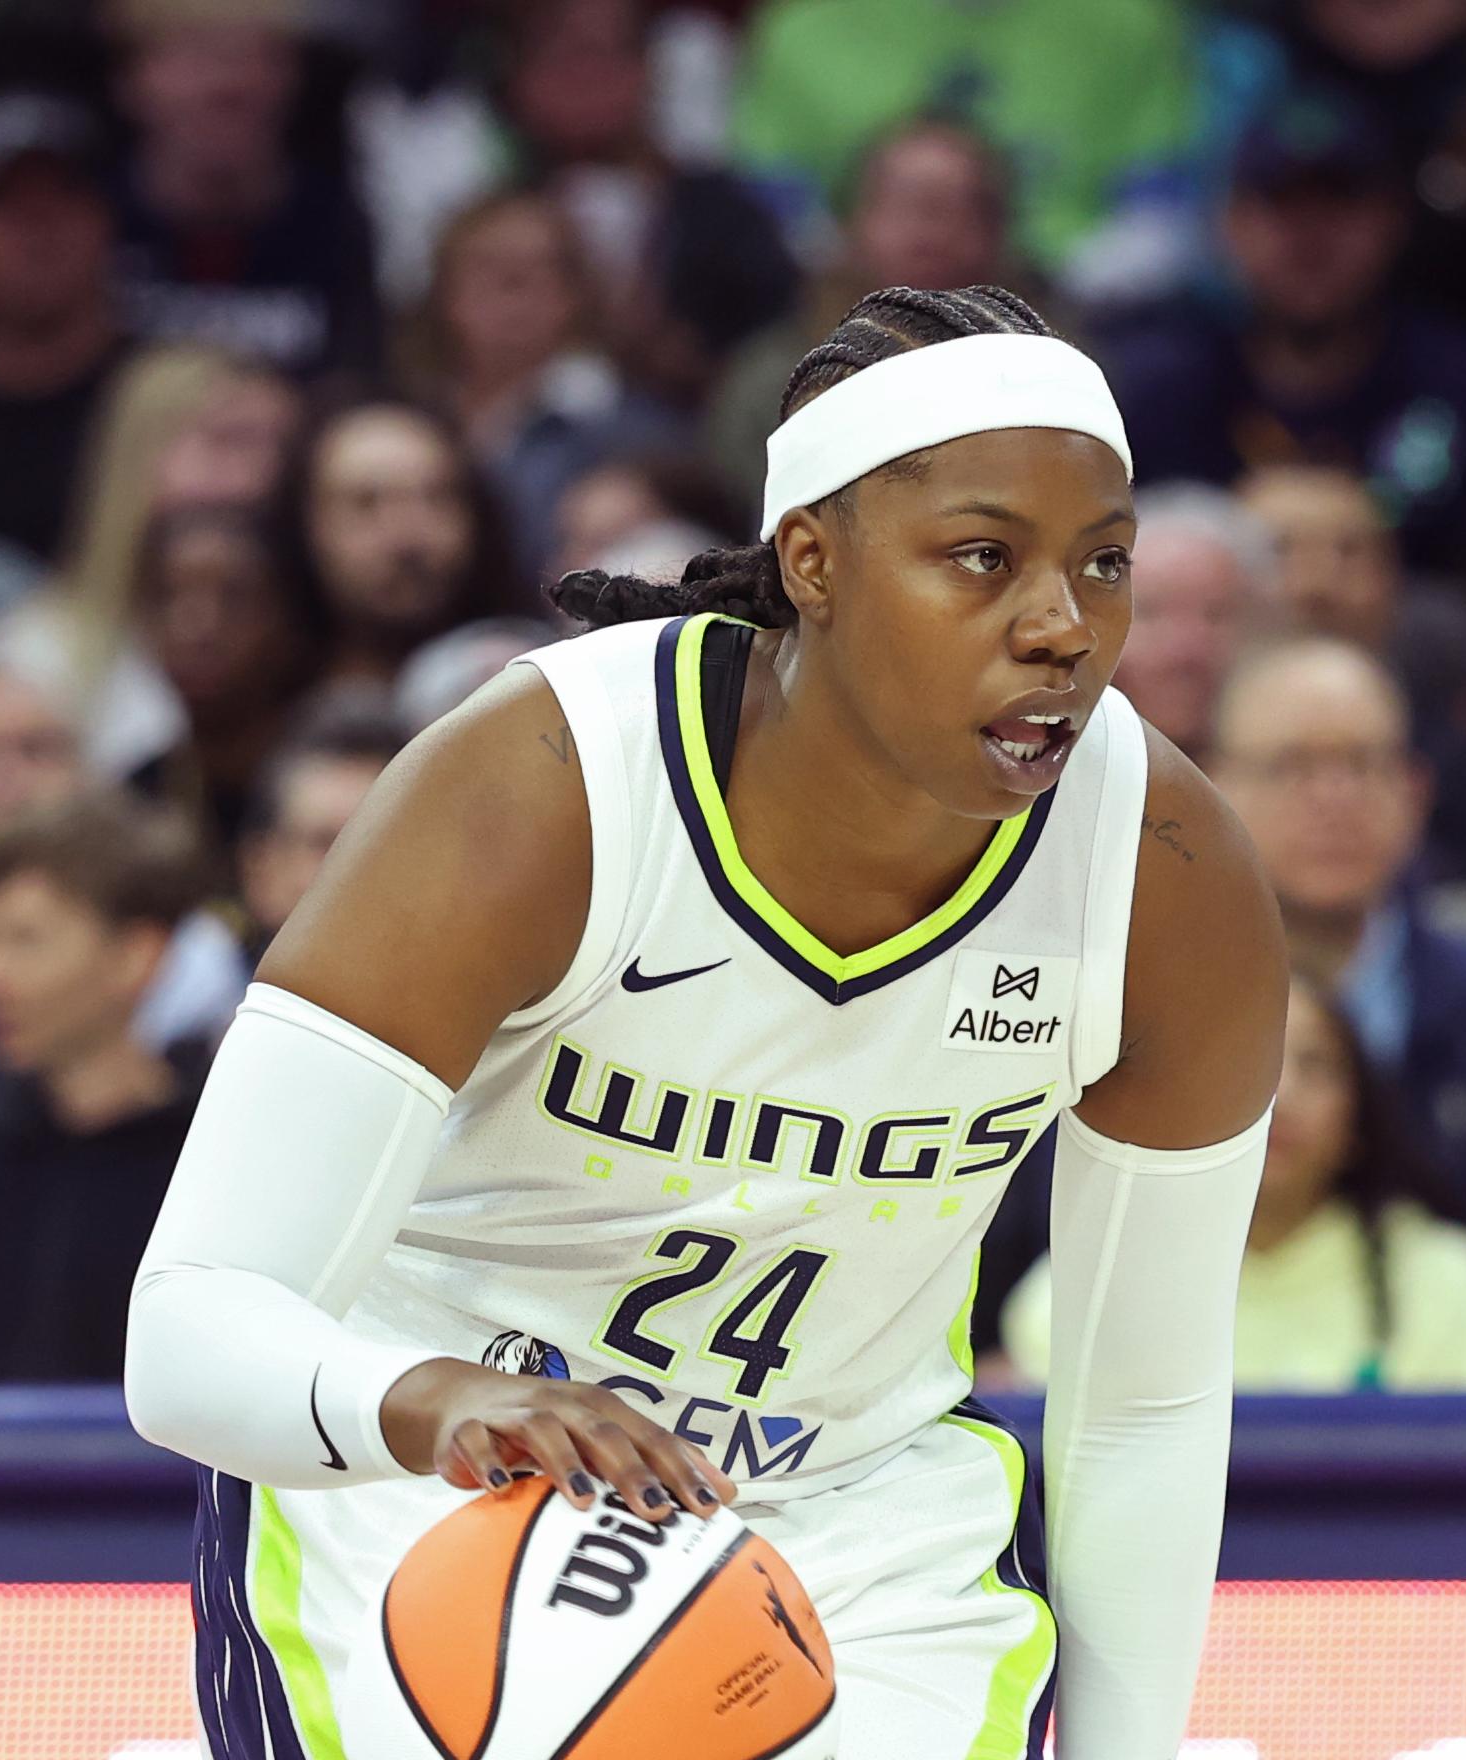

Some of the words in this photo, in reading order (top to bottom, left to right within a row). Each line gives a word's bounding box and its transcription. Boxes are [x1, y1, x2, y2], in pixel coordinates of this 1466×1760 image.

[949, 1008, 1062, 1044] Albert
[536, 1033, 1058, 1187] WINGS
[583, 1153, 965, 1223] DALLAS
[589, 1223, 840, 1406] 24
